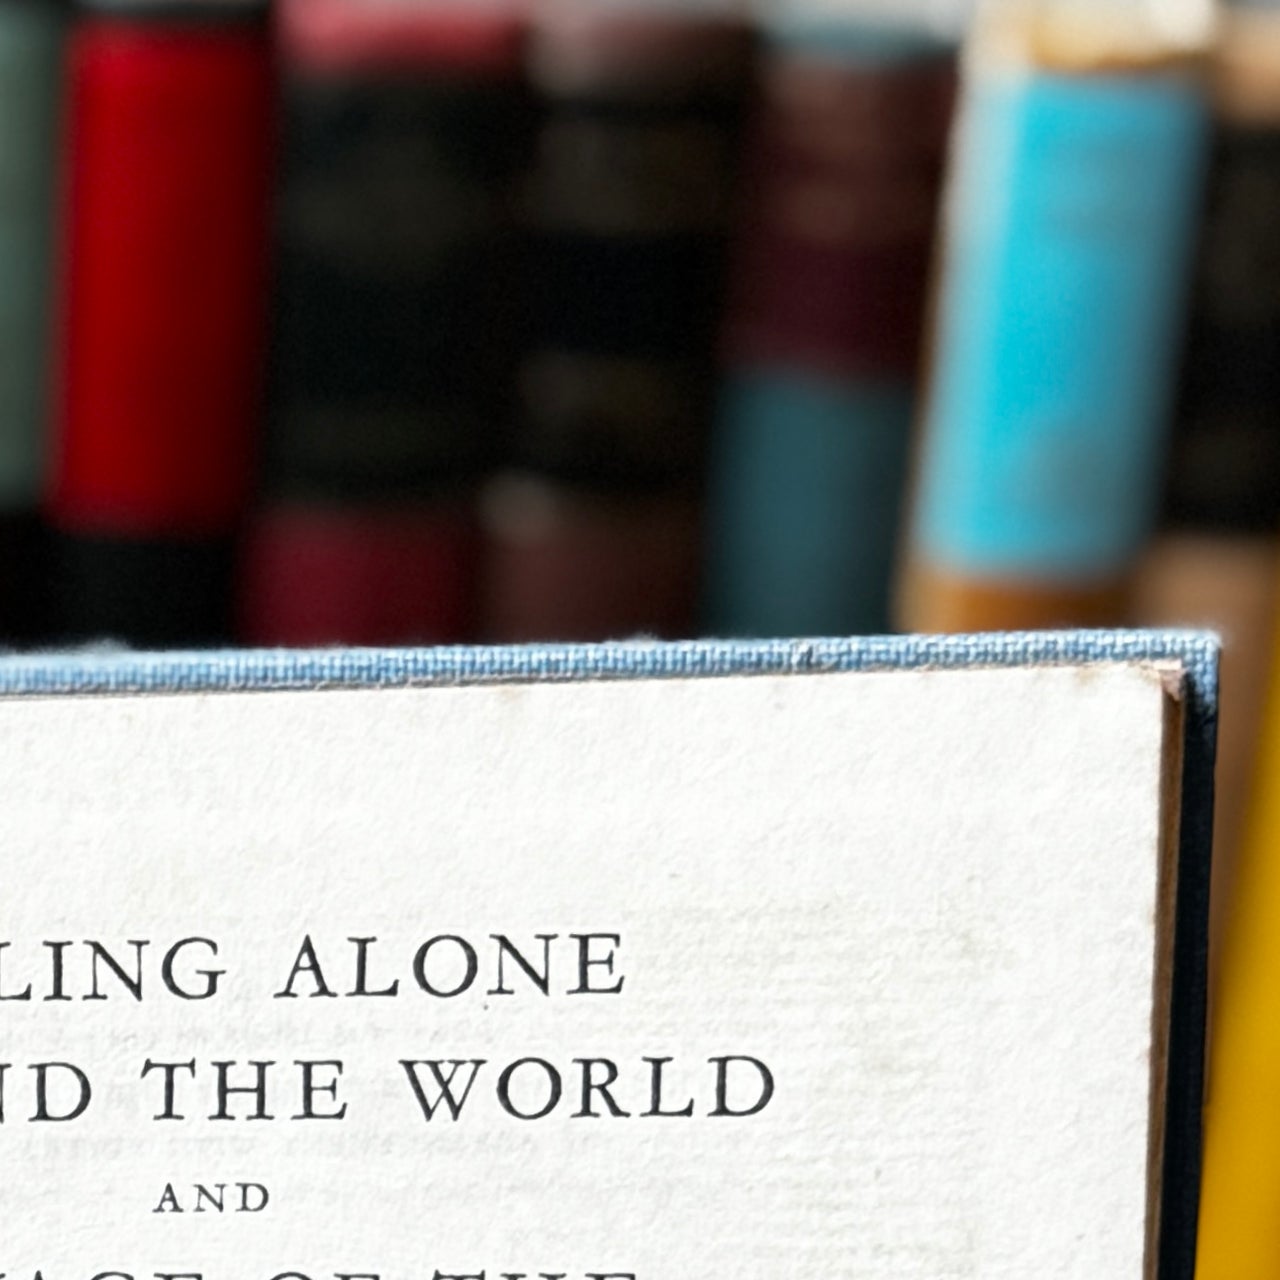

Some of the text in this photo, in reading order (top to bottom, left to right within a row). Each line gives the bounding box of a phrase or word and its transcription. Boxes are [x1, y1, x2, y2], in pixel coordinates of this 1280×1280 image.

[272, 931, 626, 1000] ALONE
[139, 1057, 349, 1122] THE
[397, 1054, 776, 1123] WORLD
[151, 1181, 271, 1215] AND
